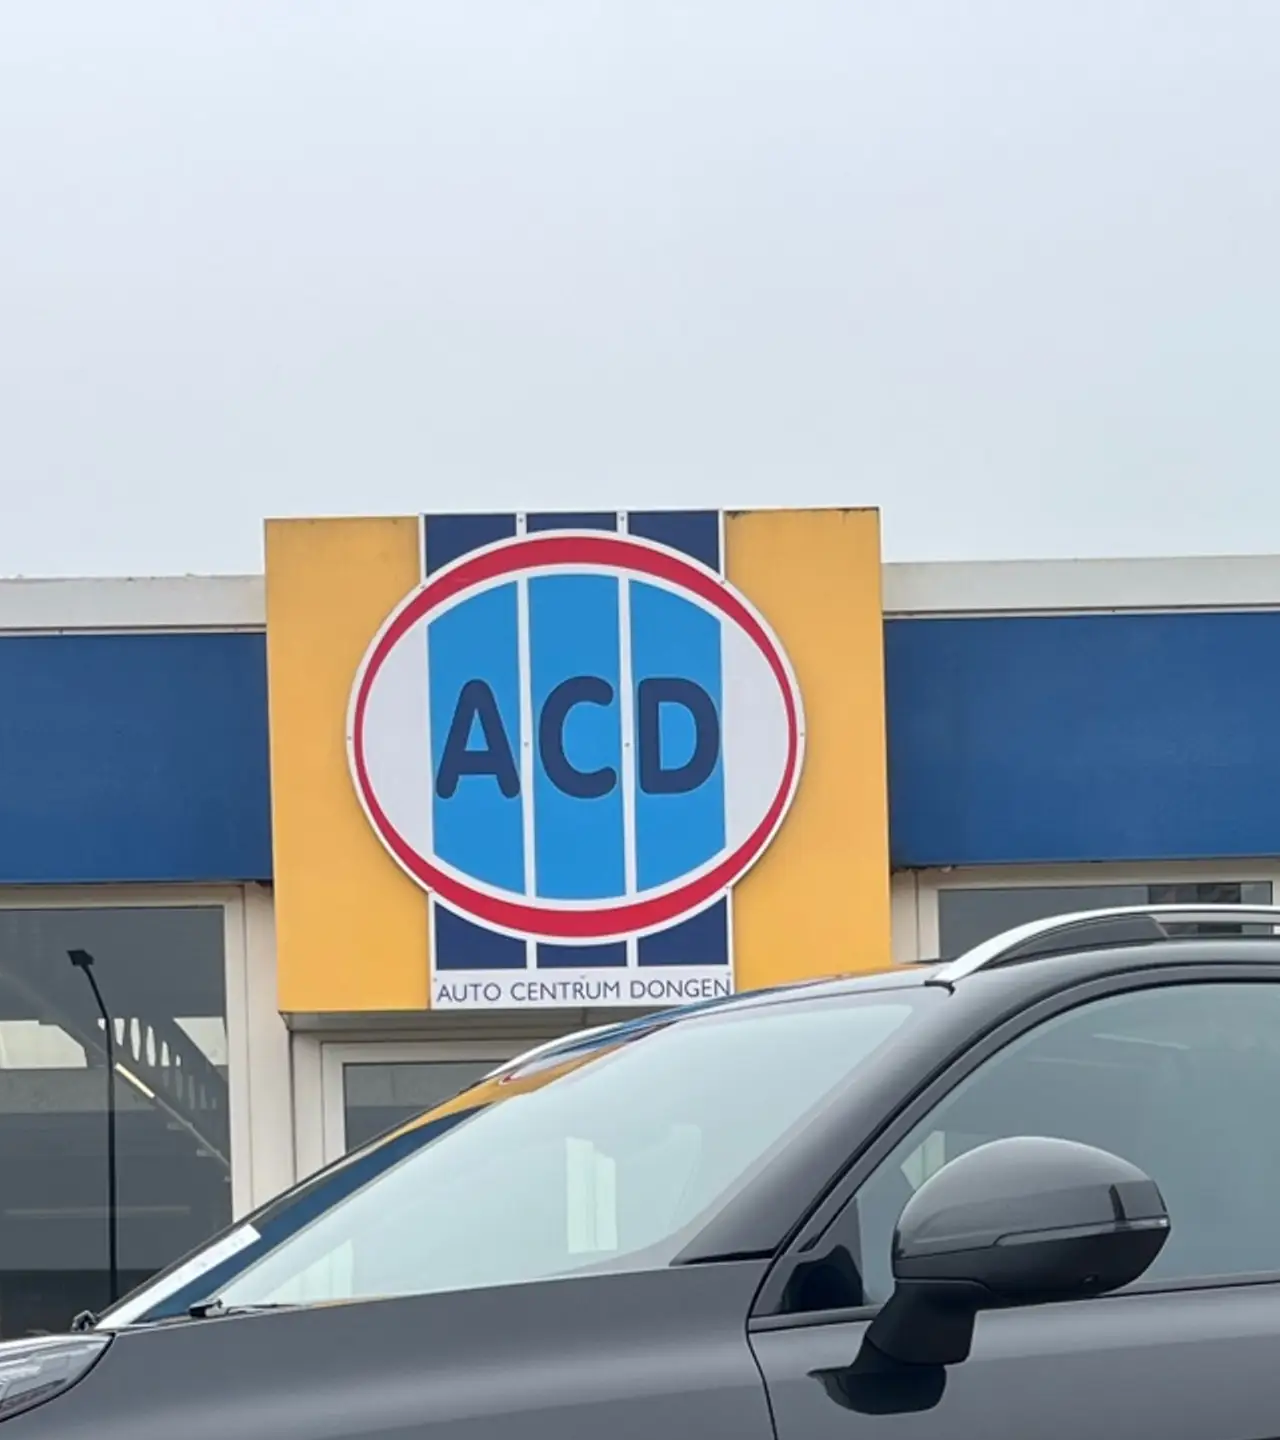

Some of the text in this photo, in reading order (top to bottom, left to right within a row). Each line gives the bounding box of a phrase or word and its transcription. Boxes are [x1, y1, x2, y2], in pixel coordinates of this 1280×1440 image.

[435, 676, 720, 799] ACD
[436, 977, 731, 1003] AUTO CENTRUM DONGEN
